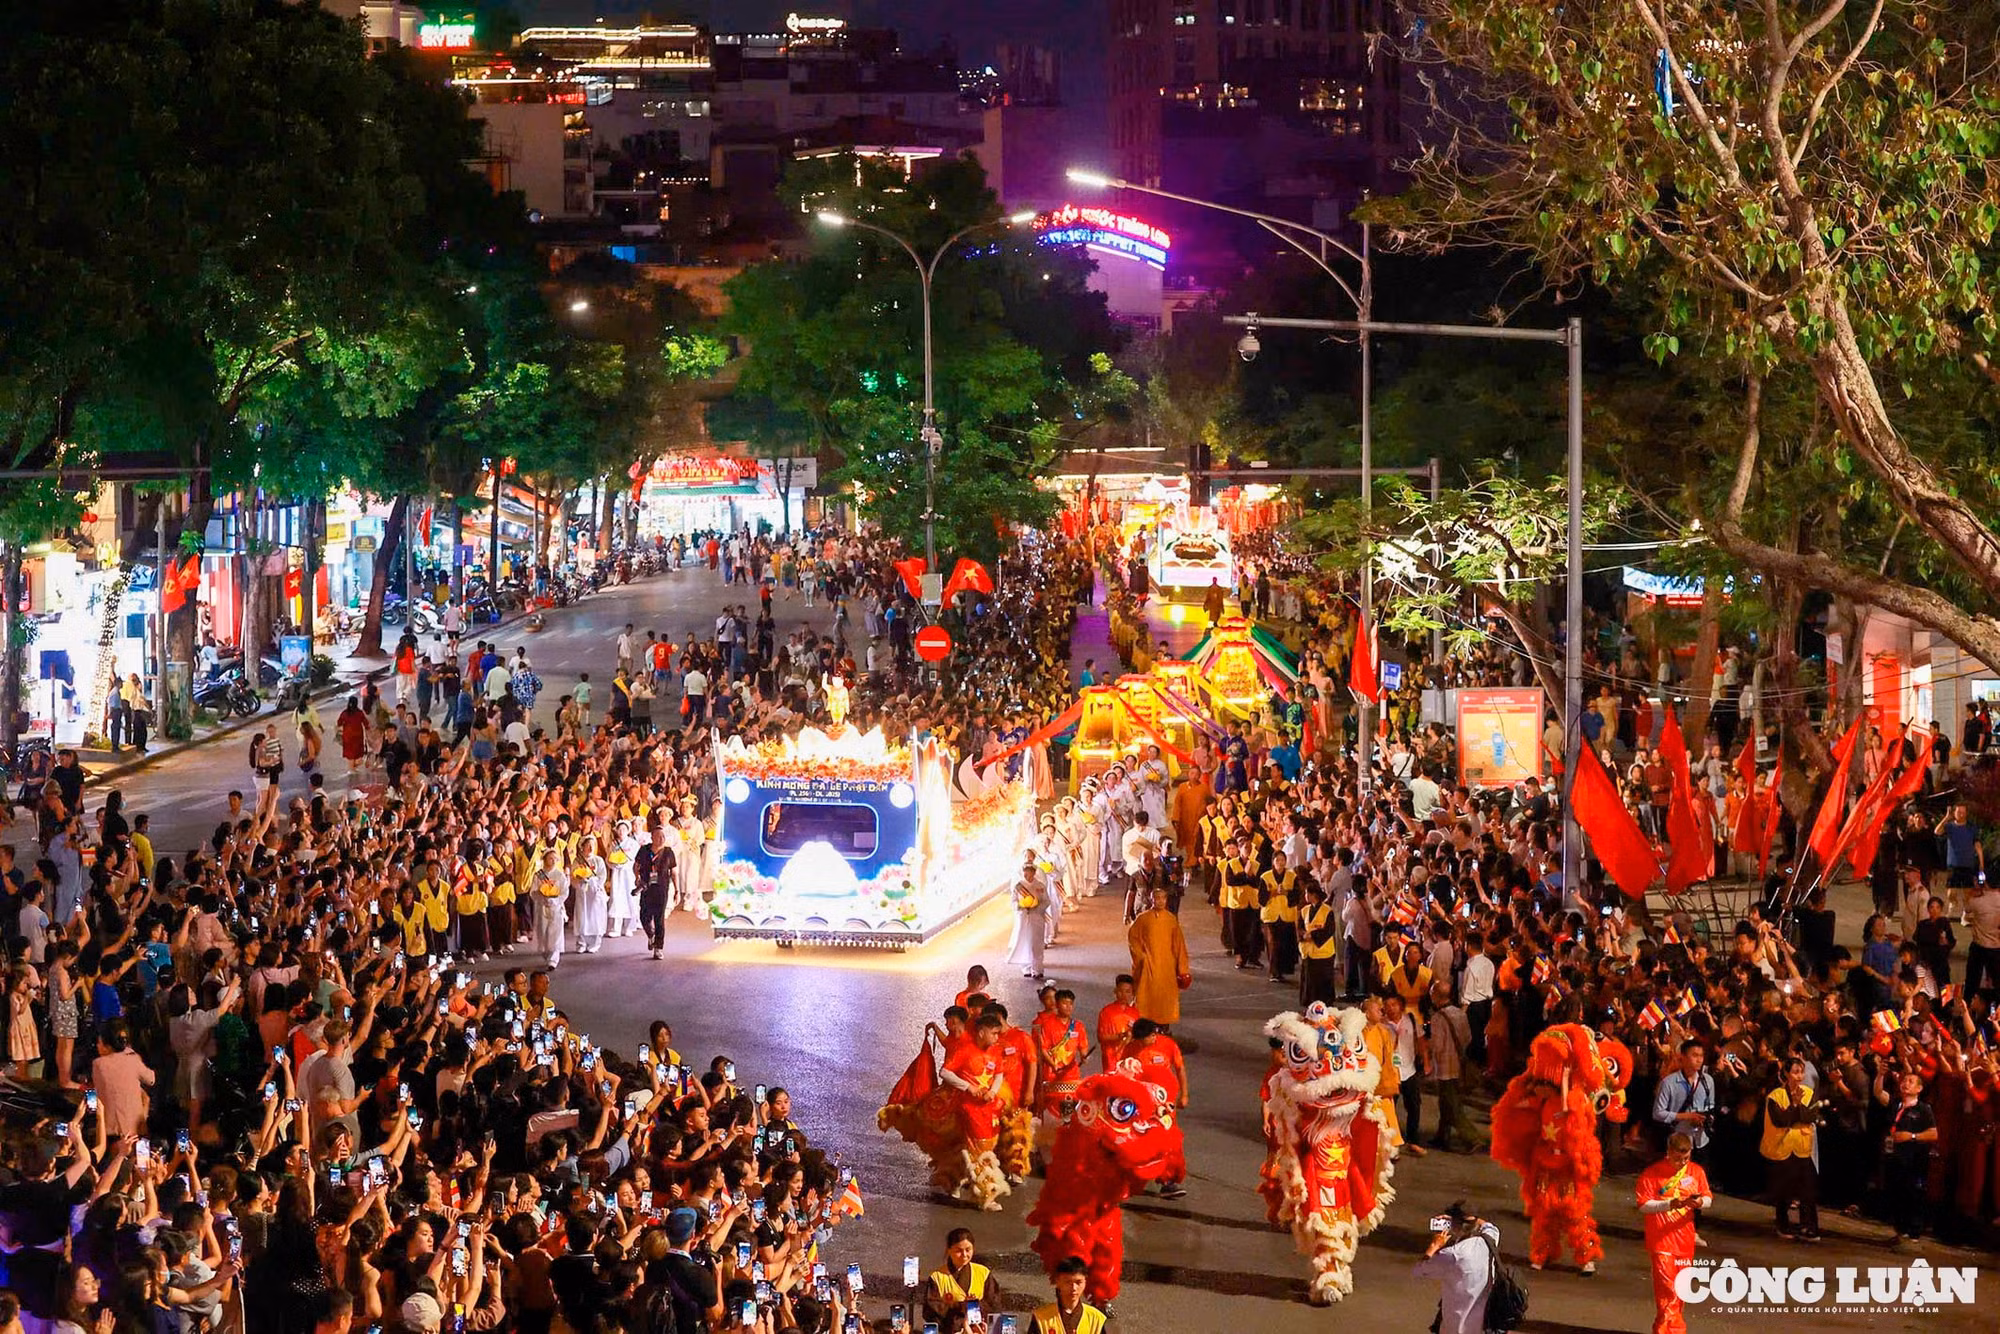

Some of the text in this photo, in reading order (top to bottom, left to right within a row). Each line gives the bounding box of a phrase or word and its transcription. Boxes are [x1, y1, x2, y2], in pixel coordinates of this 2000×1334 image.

[421, 34, 470, 47] SKY BAR
[766, 464, 784, 473] TE
